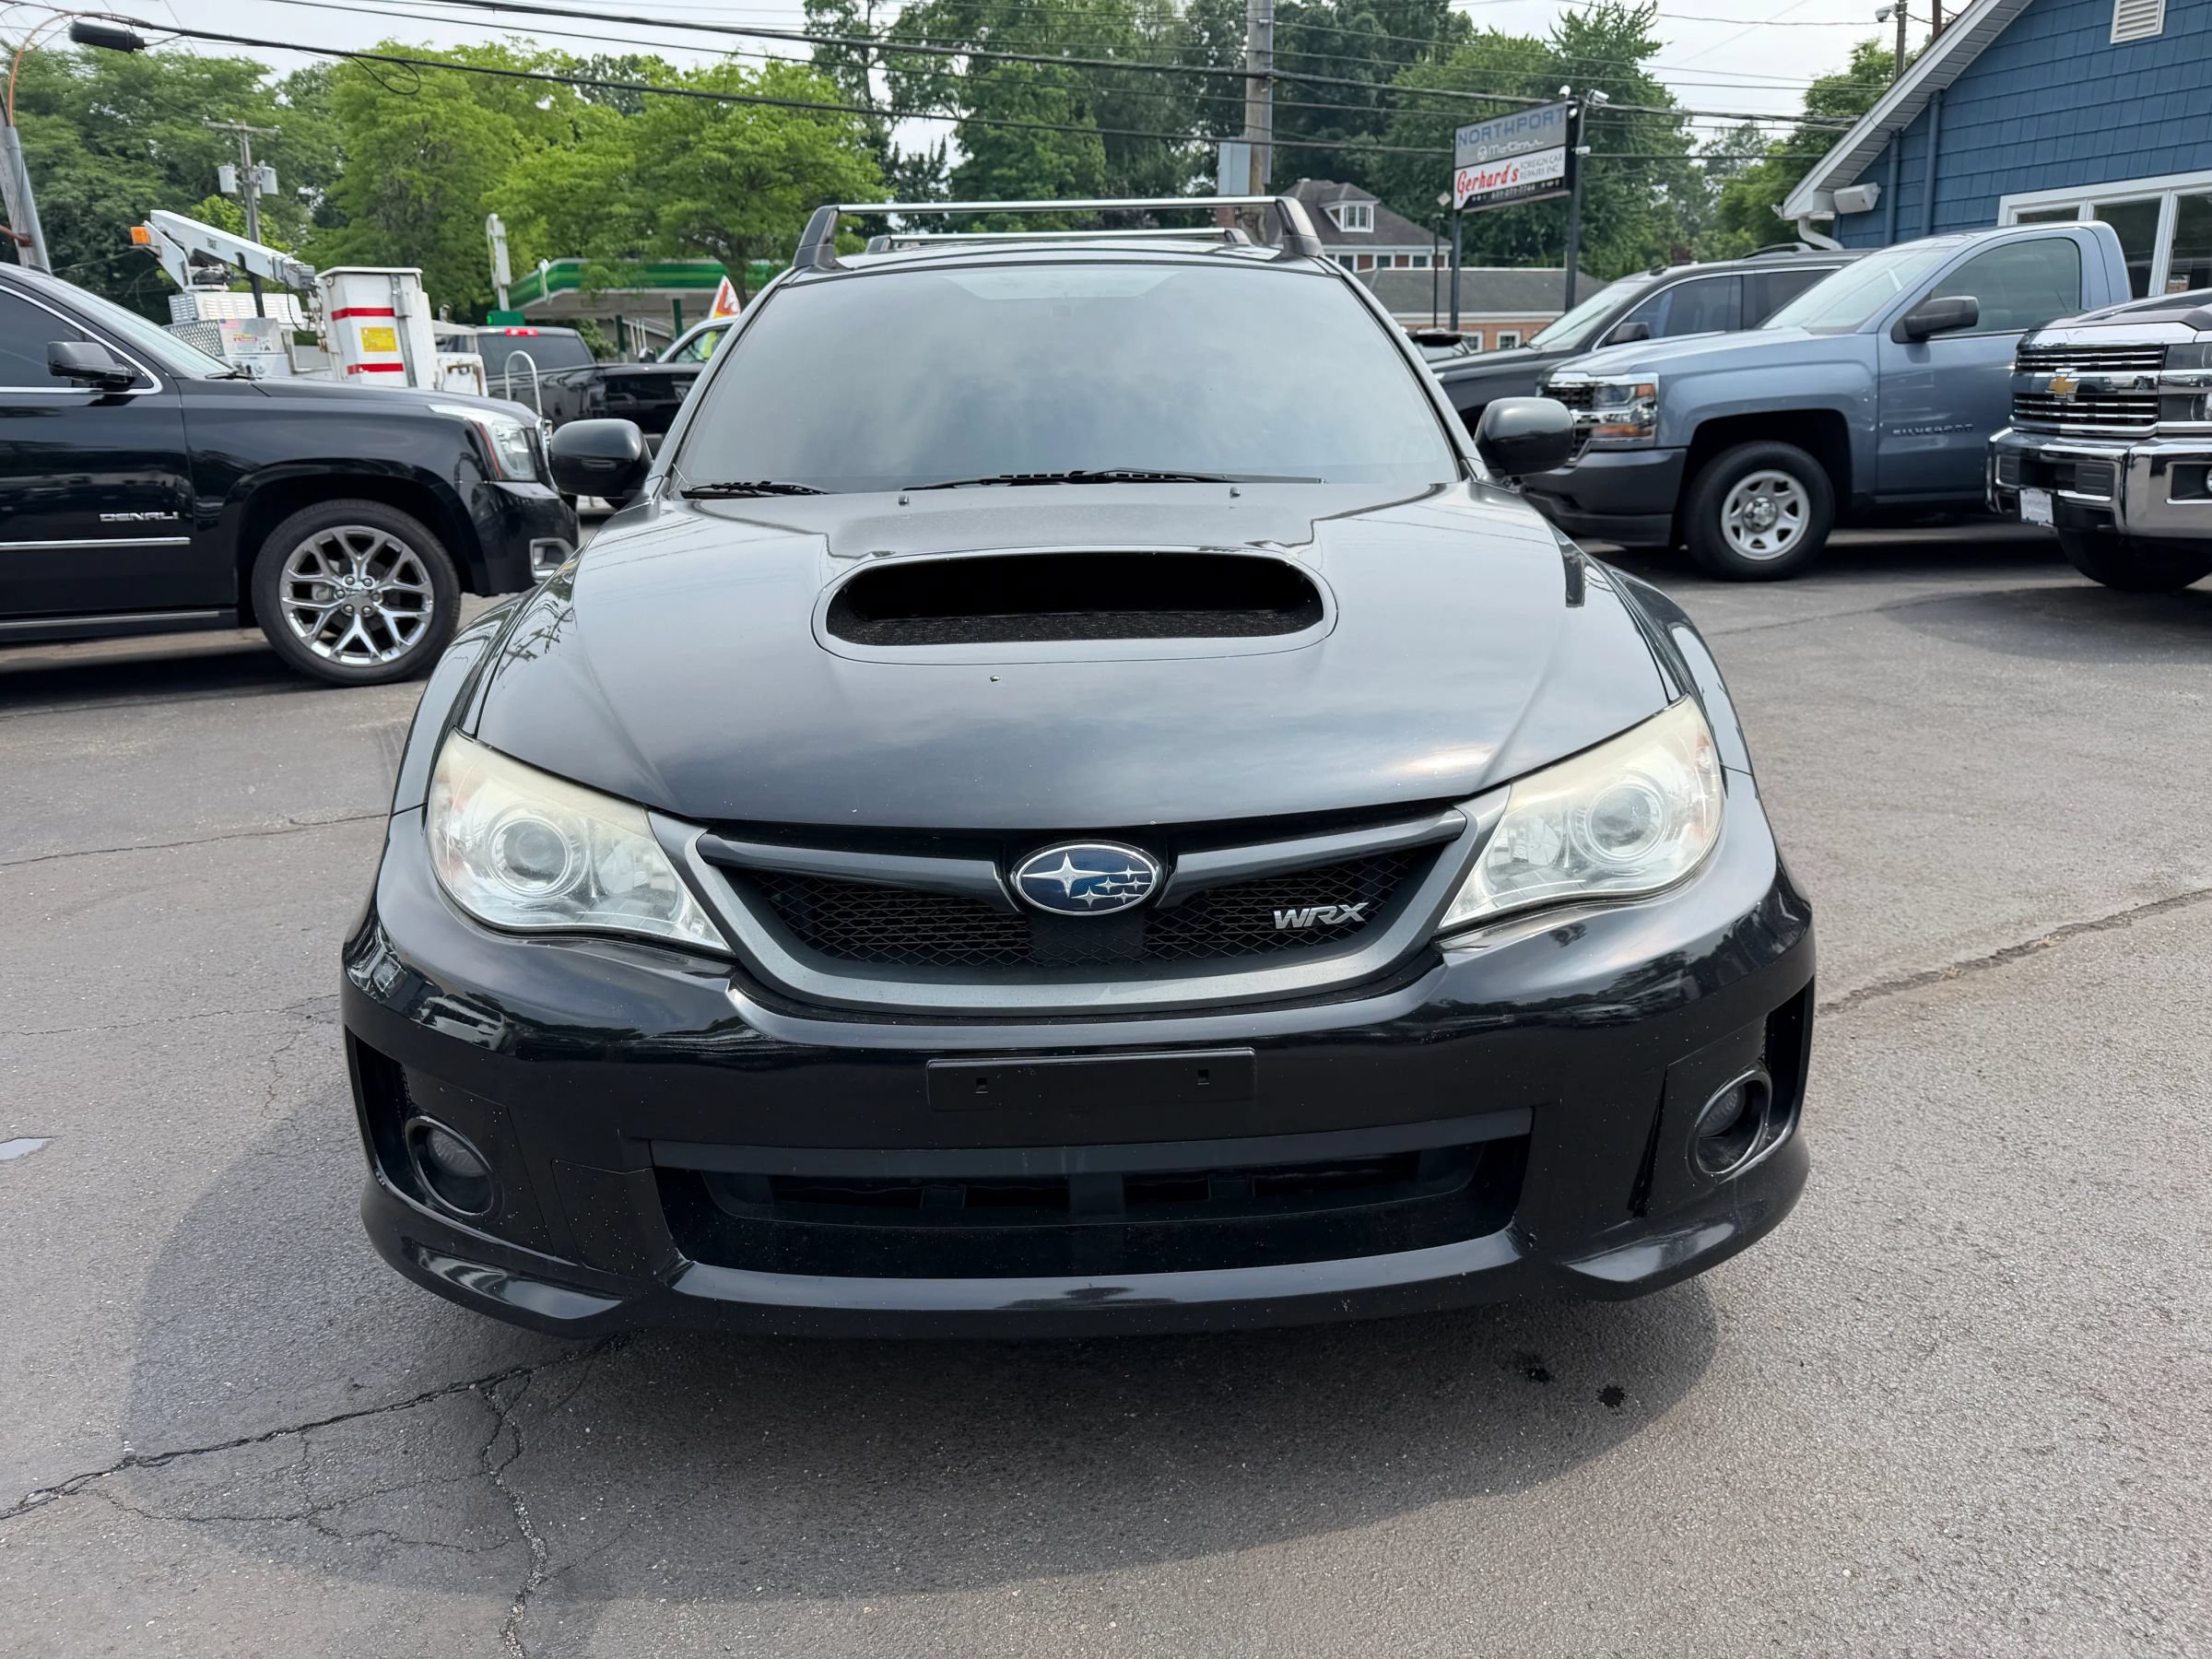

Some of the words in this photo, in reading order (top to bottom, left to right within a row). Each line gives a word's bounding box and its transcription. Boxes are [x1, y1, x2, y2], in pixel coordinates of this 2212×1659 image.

[1457, 108, 1565, 147] NORTHPORT
[1457, 162, 1519, 201] Gerhard's
[100, 512, 179, 523] DENALI
[1273, 902, 1369, 929] WRX
